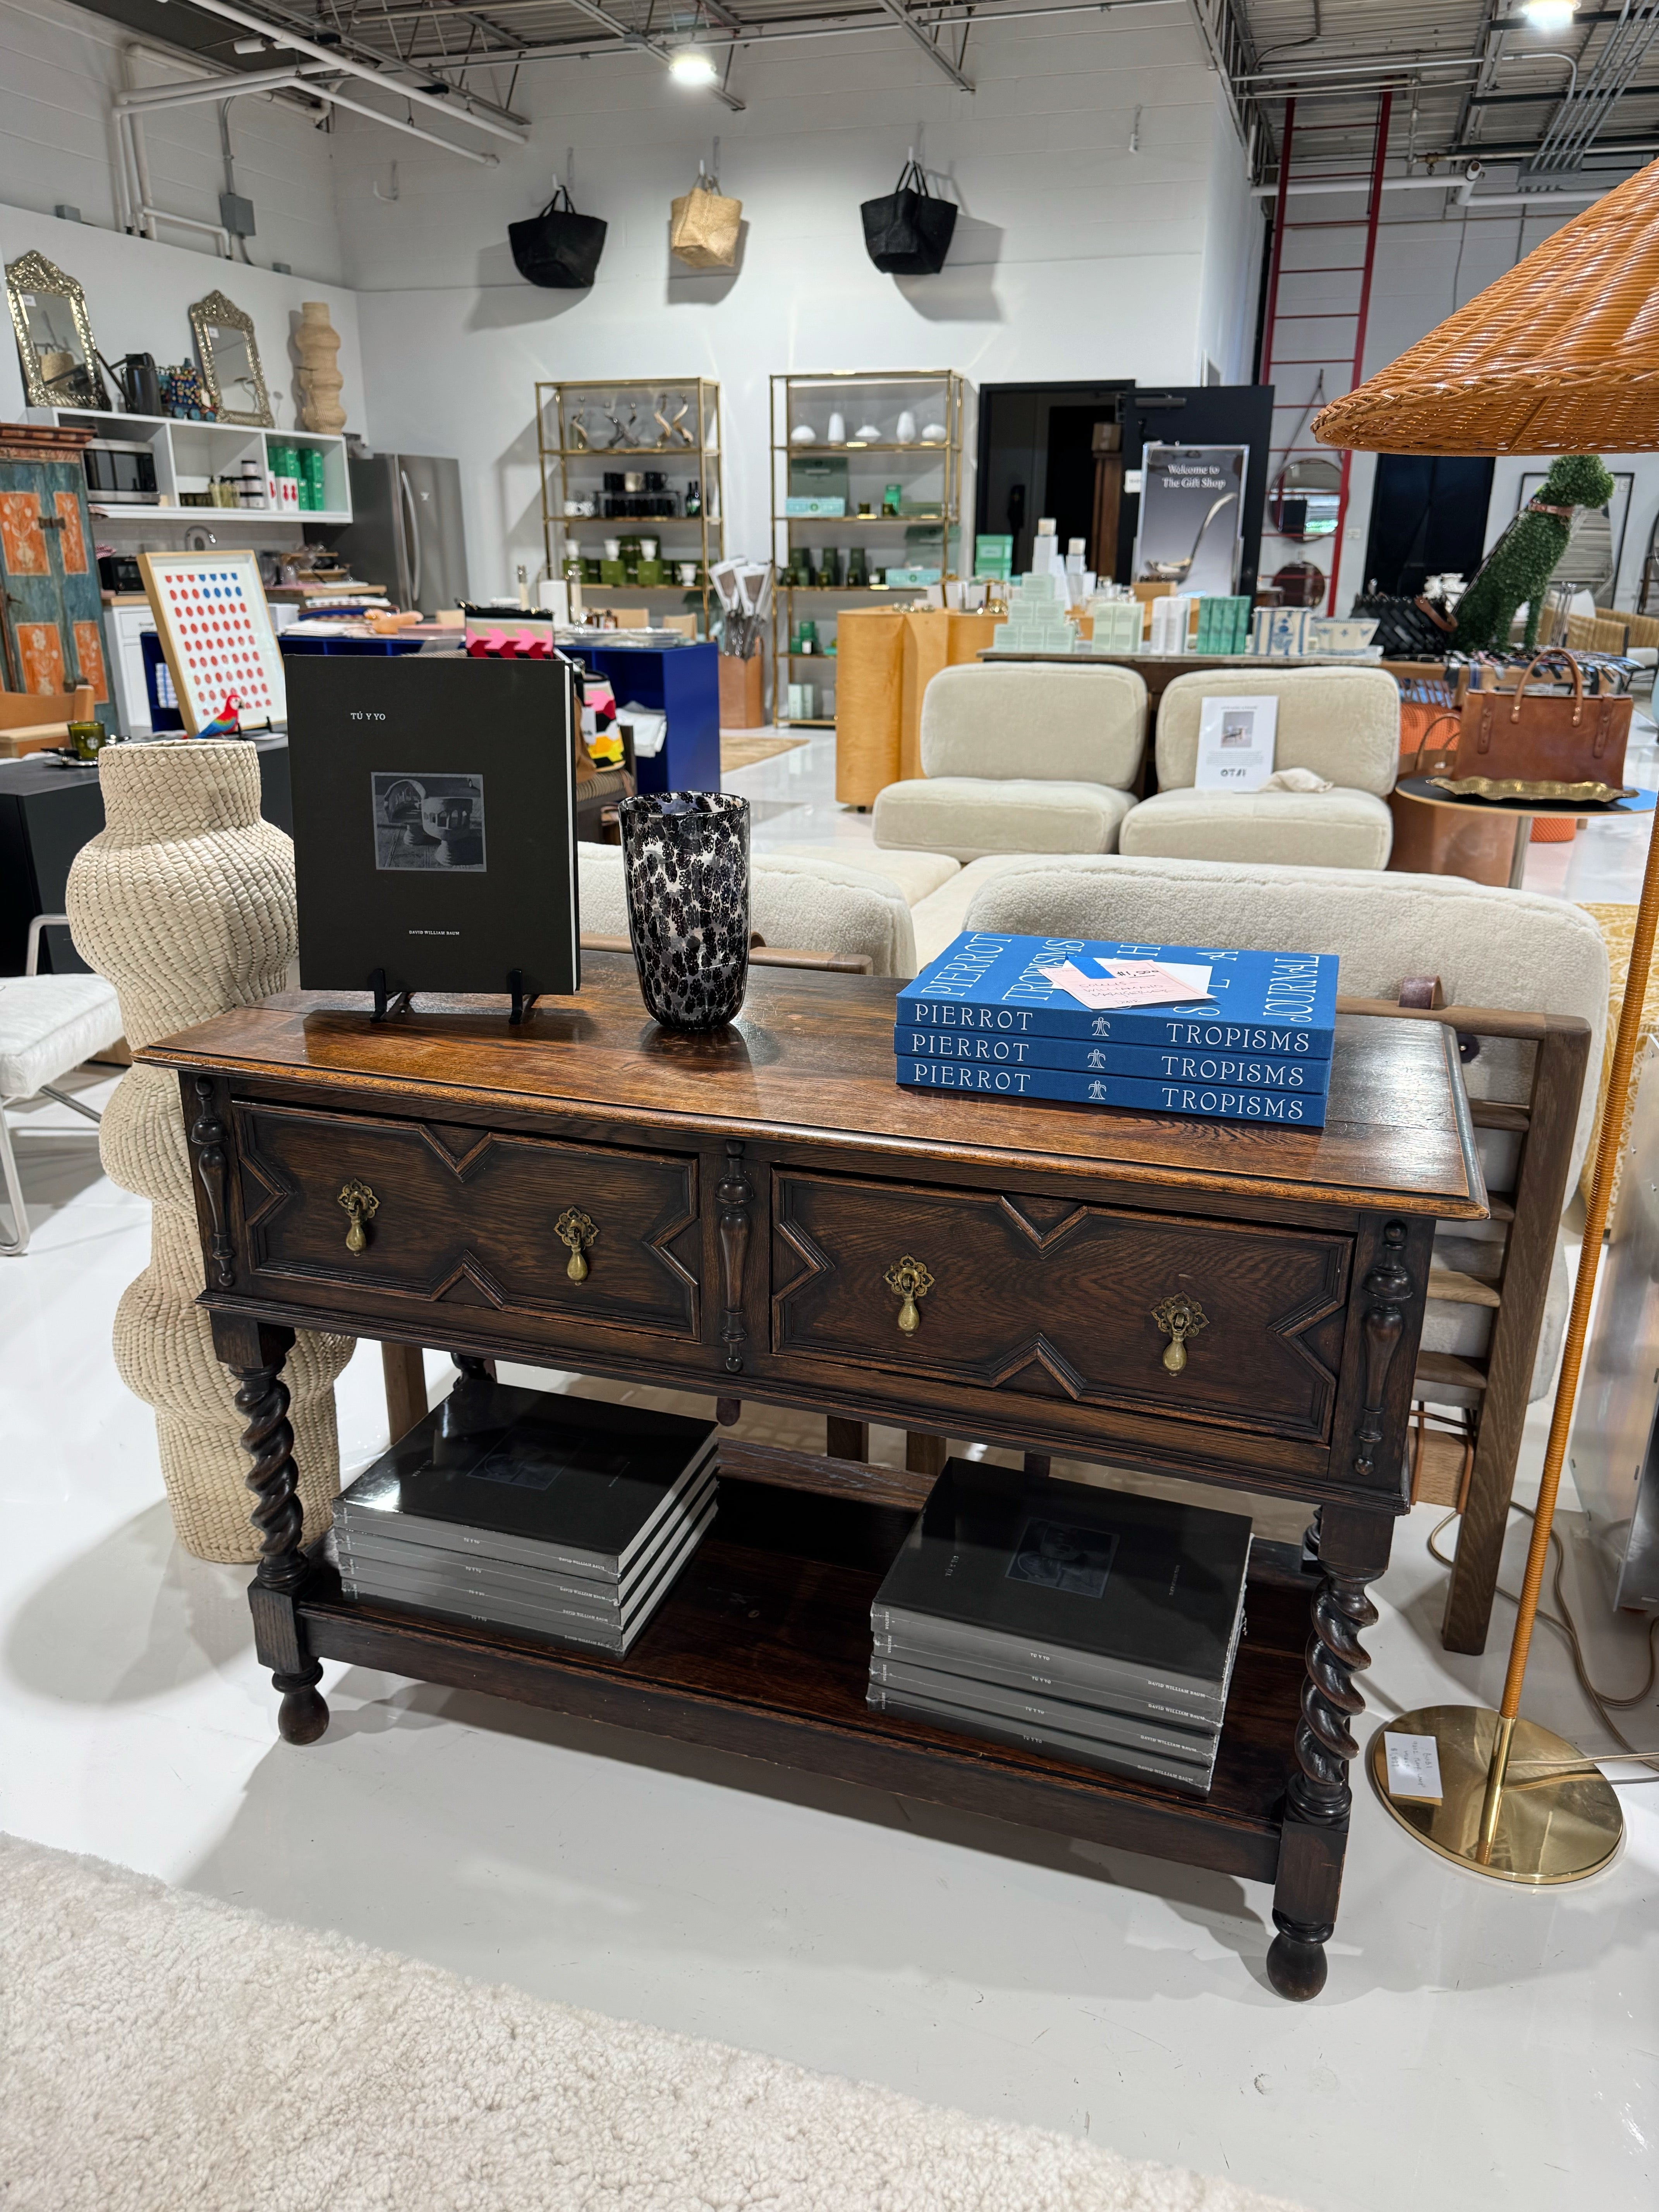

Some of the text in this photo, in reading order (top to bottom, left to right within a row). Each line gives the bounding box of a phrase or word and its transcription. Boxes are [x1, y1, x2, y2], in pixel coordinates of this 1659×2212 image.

[1168, 464, 1220, 474] Welcome to
[1162, 477, 1226, 490] The Gift Shop
[350, 711, 363, 720] TÚ
[921, 934, 1012, 996] PIERROT
[1263, 956, 1319, 1022] JOURNAL
[915, 1004, 1033, 1030] PIERROT
[912, 1034, 1029, 1061] PIERROT
[1166, 1023, 1309, 1052] TROPISMS
[914, 1064, 1030, 1092] PIERROT
[1161, 1056, 1303, 1086] TROPISMS
[1162, 1088, 1303, 1120] TROPISMS
[1165, 1684, 1189, 1693] WILLIAM
[1165, 1707, 1188, 1716] WILLIAM
[1157, 1739, 1180, 1748] WILLIAM
